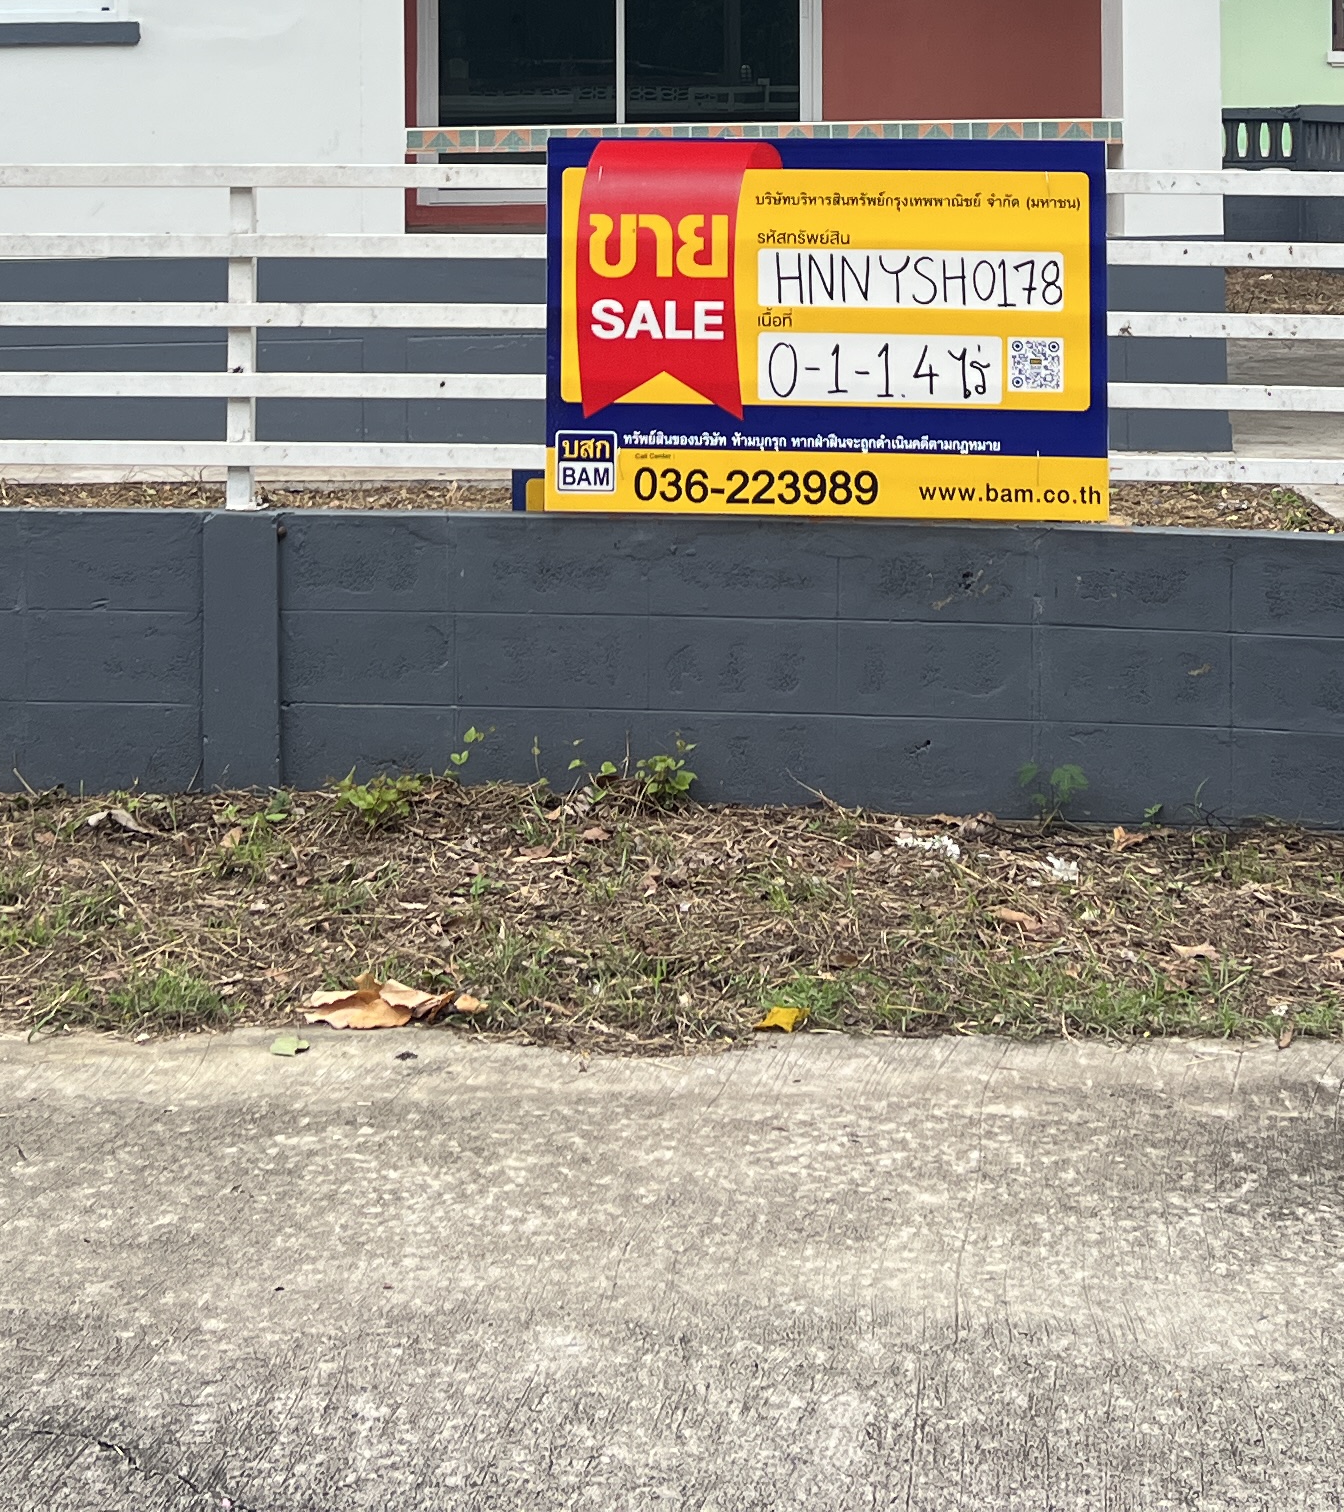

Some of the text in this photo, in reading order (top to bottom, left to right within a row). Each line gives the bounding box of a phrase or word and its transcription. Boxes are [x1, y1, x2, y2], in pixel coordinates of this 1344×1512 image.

[755, 191, 1081, 212] บริษัทบริหารสินทรัพย์กรุงเทพพาณิชย์ จำกัด (มหาชน)
[589, 213, 729, 278] ขาย
[757, 228, 851, 245] รหัสทรัพย์สิน
[590, 298, 725, 341] SALE
[757, 307, 793, 328] เนื้อที่
[561, 437, 611, 460] บสก
[623, 429, 727, 447] ทรัพย์สินของบริษัท
[731, 432, 787, 452] ห้ามบุกรุก
[562, 466, 610, 487] BAM
[634, 466, 879, 506] 036-223989
[919, 482, 1101, 505] www.bam.co.th
